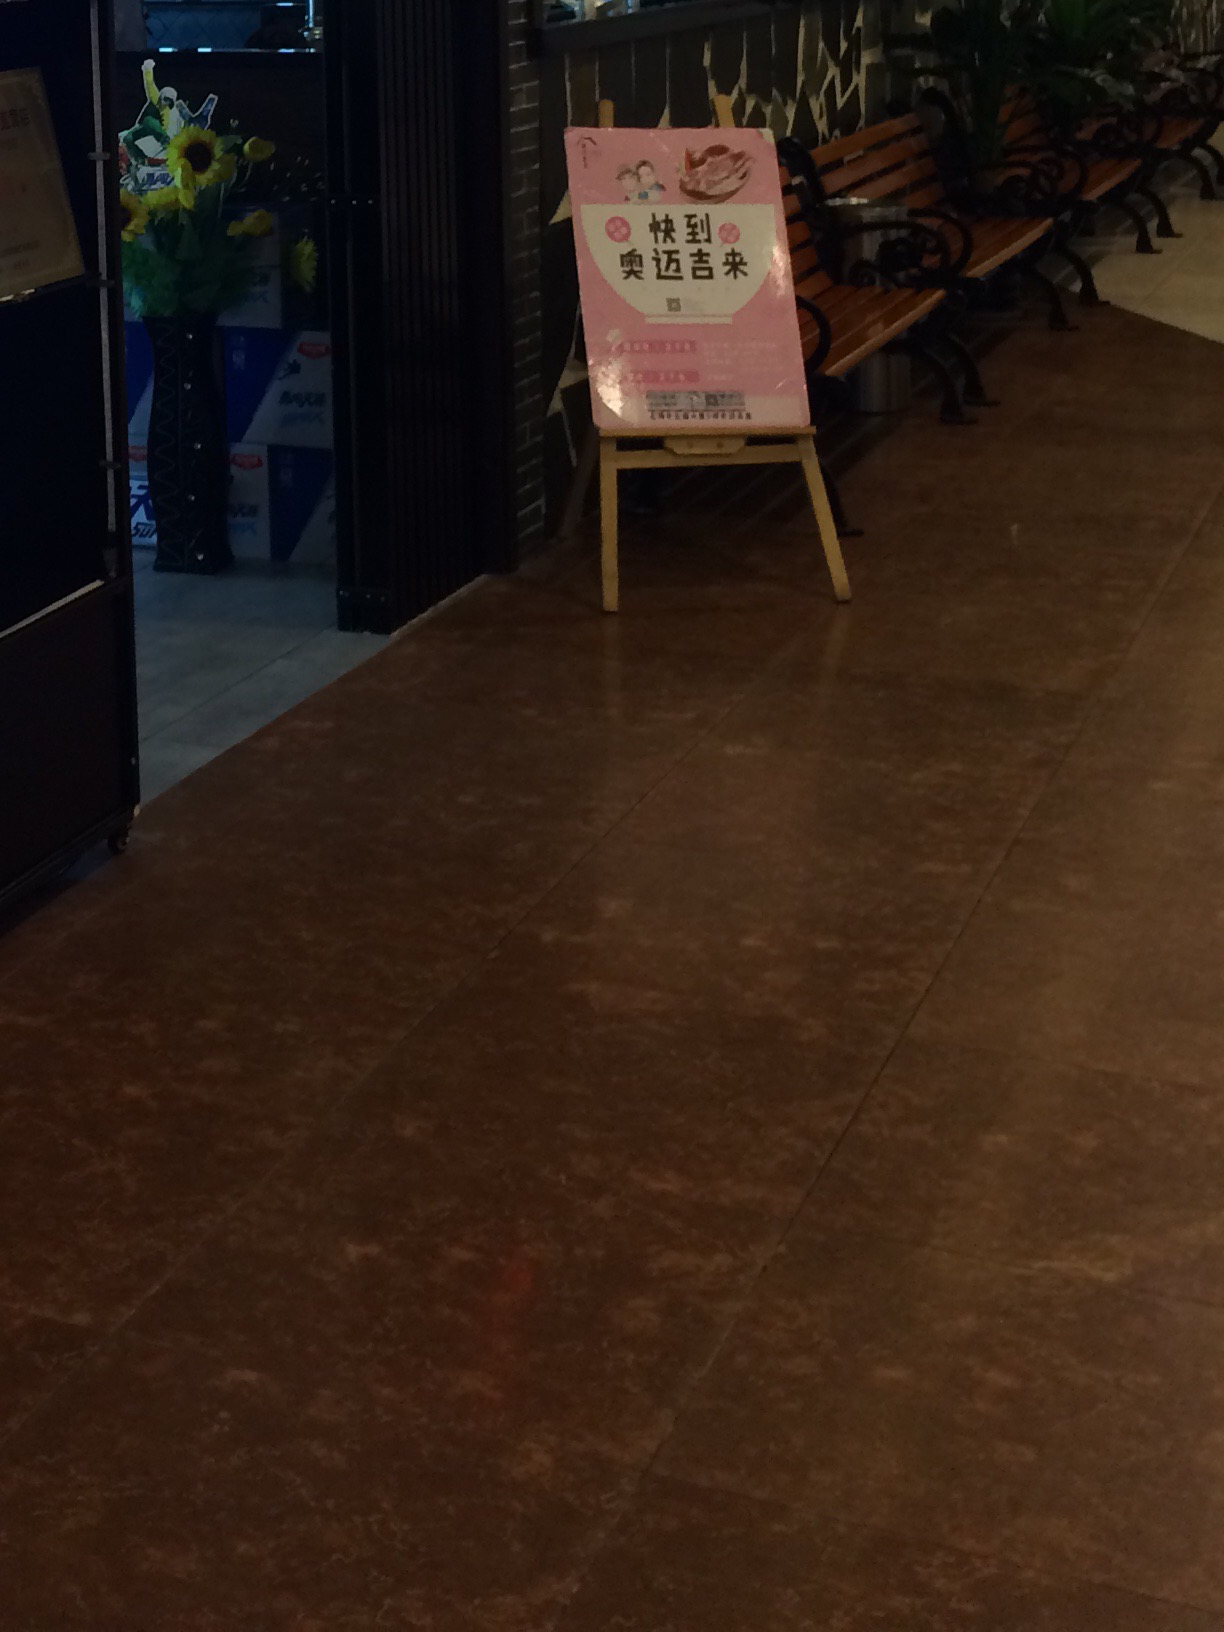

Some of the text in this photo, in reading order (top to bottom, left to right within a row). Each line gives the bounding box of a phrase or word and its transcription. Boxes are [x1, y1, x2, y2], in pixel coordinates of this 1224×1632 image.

[648, 212, 713, 245] 快到
[619, 247, 749, 281] 奥迈吉来
